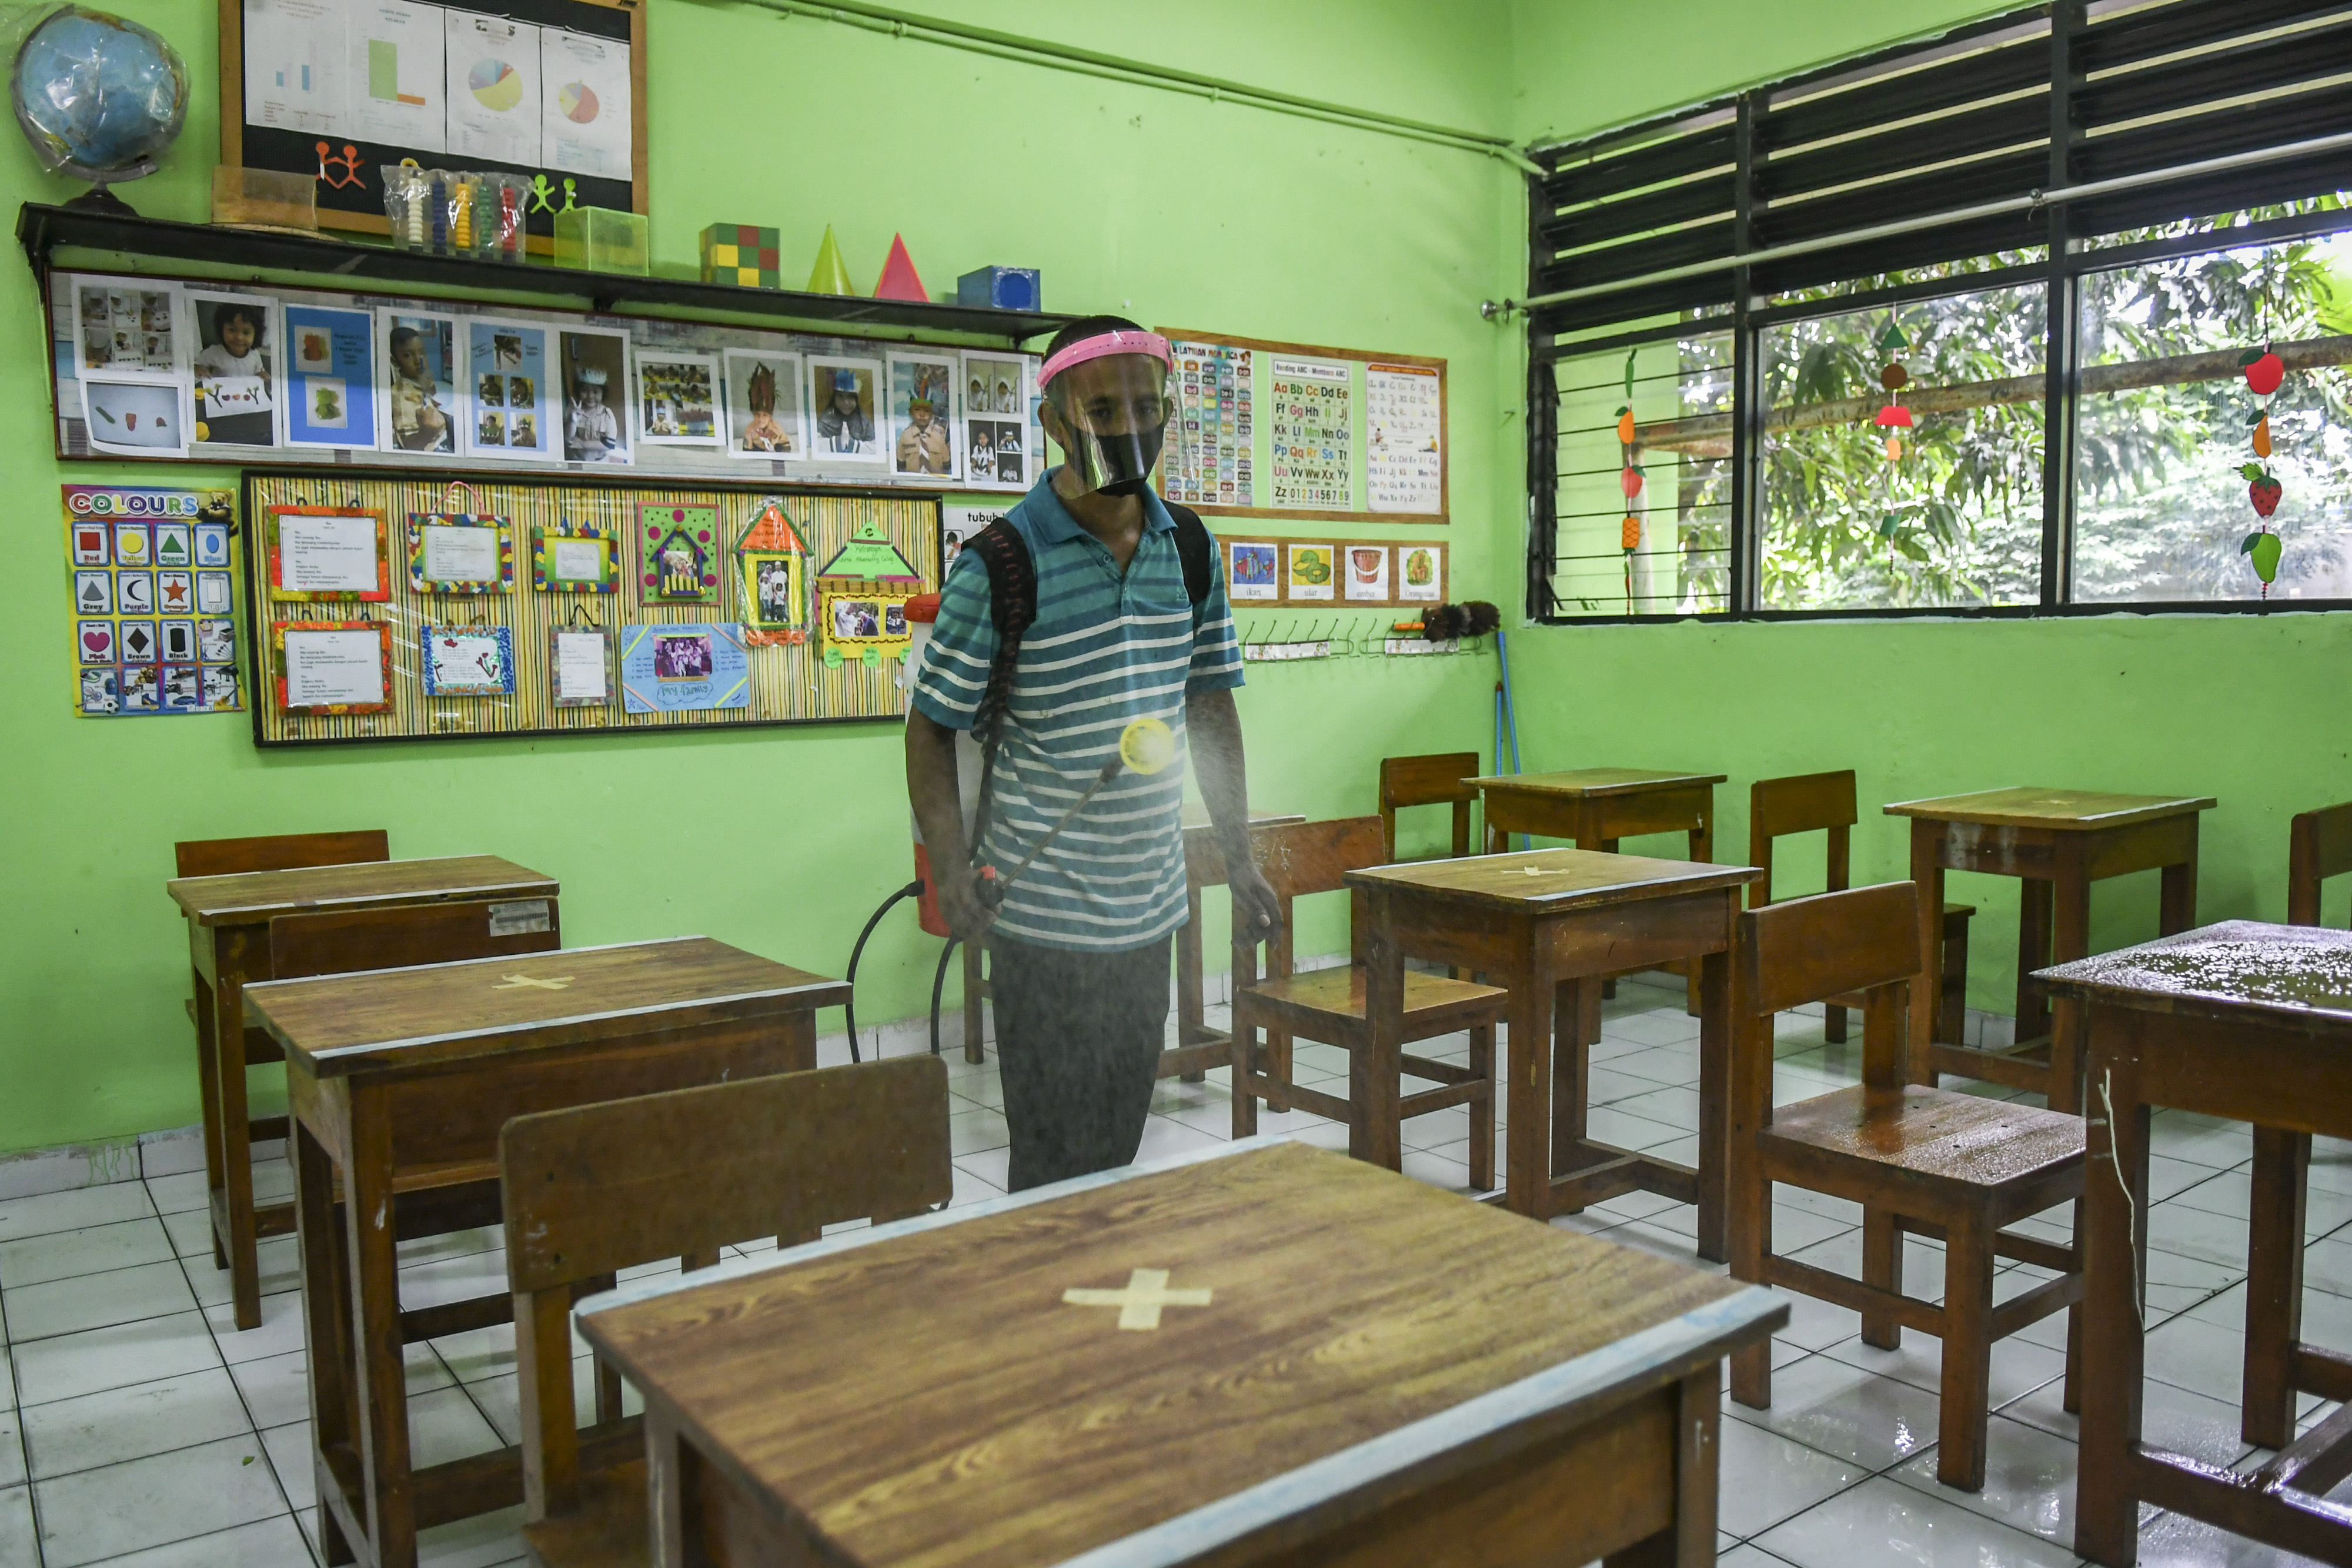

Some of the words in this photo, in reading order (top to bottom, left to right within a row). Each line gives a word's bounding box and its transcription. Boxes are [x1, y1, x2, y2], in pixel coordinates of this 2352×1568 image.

[1180, 346, 1206, 357] LATIHAN
[1208, 350, 1238, 359] MEMBACA
[1277, 364, 1295, 373] Reading
[1274, 382, 1287, 393] Aa
[1290, 384, 1303, 394] Bb
[1306, 385, 1318, 396] Cc
[1321, 387, 1334, 397] Dd
[1337, 389, 1348, 399] Ee
[1276, 403, 1285, 413] Ff
[1290, 404, 1303, 418] Gg
[1305, 406, 1318, 416] Hh
[1325, 408, 1331, 417] Ii
[1339, 409, 1347, 421] Jj
[1275, 424, 1287, 434] Kk
[1293, 426, 1301, 436] Ll
[1305, 426, 1319, 437] Mm
[1322, 428, 1334, 439] Nn
[1337, 429, 1349, 440] Oo
[1275, 444, 1287, 457] Pp
[1290, 446, 1304, 459] Qq
[1307, 447, 1317, 457] Rr
[1322, 449, 1334, 459] Ss
[1338, 450, 1347, 460] Tt
[1274, 466, 1288, 476] Uu
[1291, 467, 1303, 477] Vv
[1305, 469, 1319, 479] Ww
[1322, 469, 1334, 480] Xx
[1338, 469, 1348, 482] Yy
[1275, 487, 1287, 497] Zz
[1291, 489, 1295, 498] 0
[1297, 489, 1300, 497] 1
[1302, 489, 1307, 499] 2
[1308, 489, 1313, 499] 3
[1315, 490, 1319, 499] 4
[1321, 490, 1325, 499] 5
[1326, 490, 1331, 500] 6
[1332, 491, 1336, 500] 7
[1339, 491, 1343, 500] 8
[1345, 492, 1349, 501] 9
[69, 493, 199, 516] COLOURS
[968, 512, 998, 522] tubuh
[662, 687, 678, 696] My
